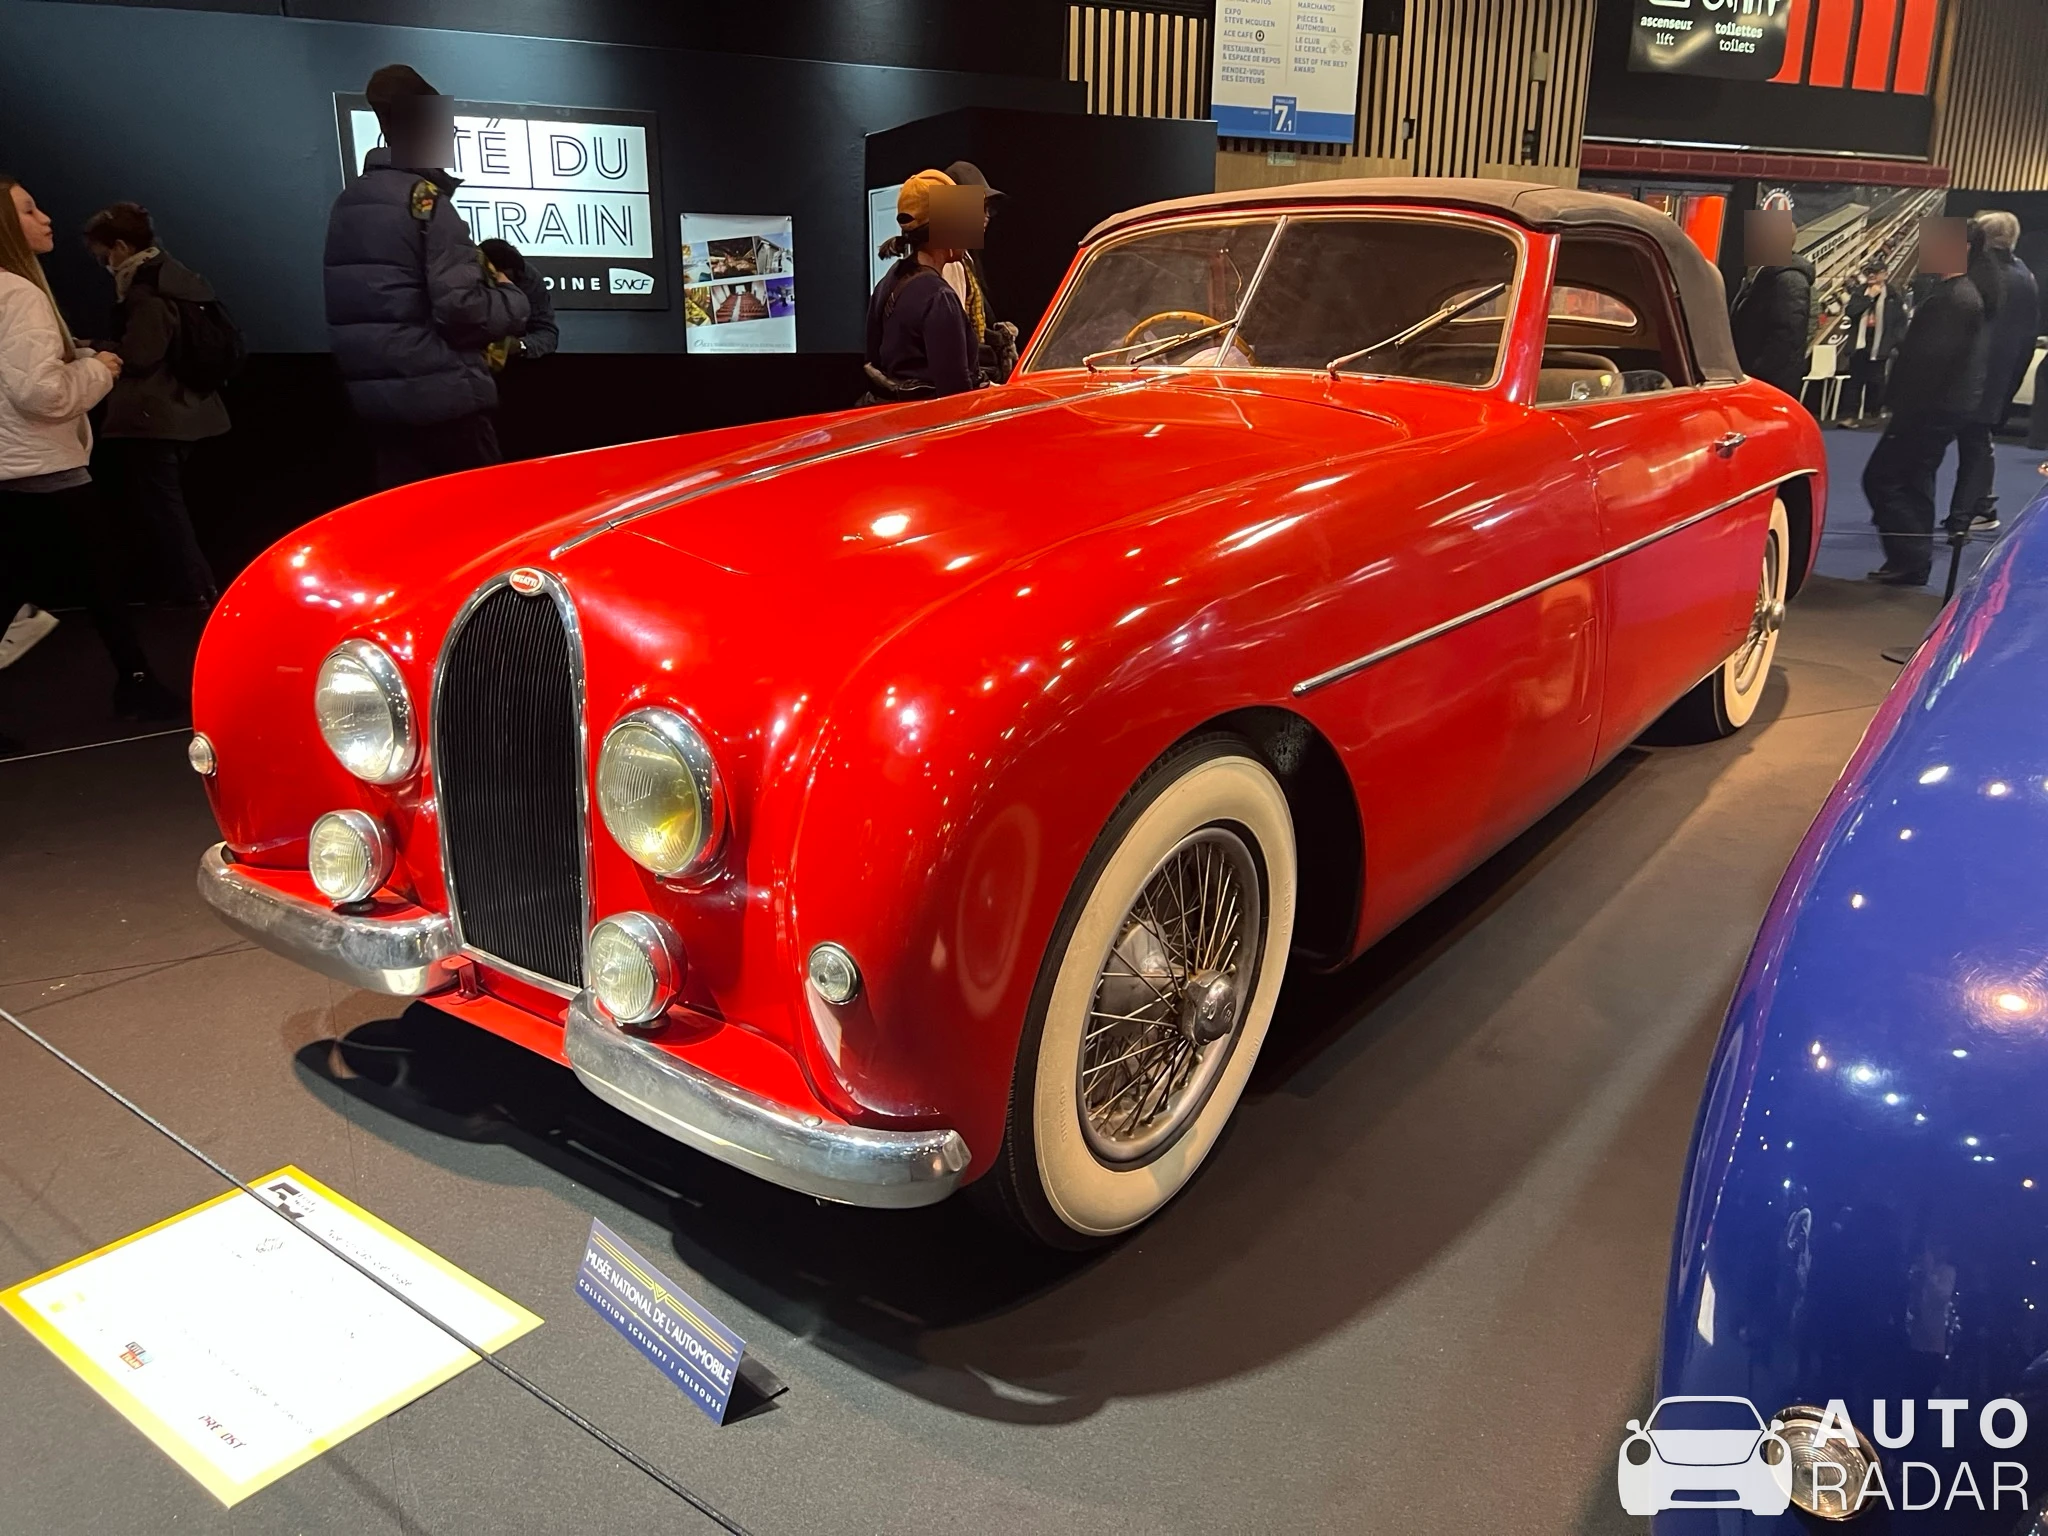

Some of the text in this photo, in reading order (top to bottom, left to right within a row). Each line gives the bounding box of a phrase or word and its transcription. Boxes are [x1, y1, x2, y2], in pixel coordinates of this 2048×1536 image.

[1224, 8, 1242, 16] EXPO
[1298, 2, 1336, 12] MARCHANDS
[1224, 16, 1276, 28] STEVE MCQUEEN
[1640, 15, 1694, 31] ascenseur
[1224, 30, 1236, 38] ACE
[1296, 24, 1336, 34] AUTOMOBILIA
[1714, 21, 1764, 39] toilettes
[1304, 38, 1320, 46] CLUB
[1655, 32, 1675, 46] lift
[1222, 44, 1266, 54] RESTAURANTS
[1294, 44, 1326, 54] LE CERCLE
[1719, 38, 1756, 54] toilets
[1228, 54, 1252, 62] ESPACE
[1262, 56, 1280, 64] REPOS
[1294, 58, 1310, 66] BEST
[1332, 60, 1348, 68] BEST
[1222, 66, 1264, 76] RENDEZ-VOUS
[1294, 66, 1316, 74] AWARD
[1222, 74, 1234, 82] DES
[1274, 104, 1292, 132] 7.1
[550, 134, 629, 180] DU
[456, 199, 634, 247] TRAIN
[613, 278, 651, 291] SNCF
[579, 1278, 625, 1325] COLLECTION
[586, 1248, 732, 1386] MUSÉE NATIONAL DE L'AUTOMOBILE
